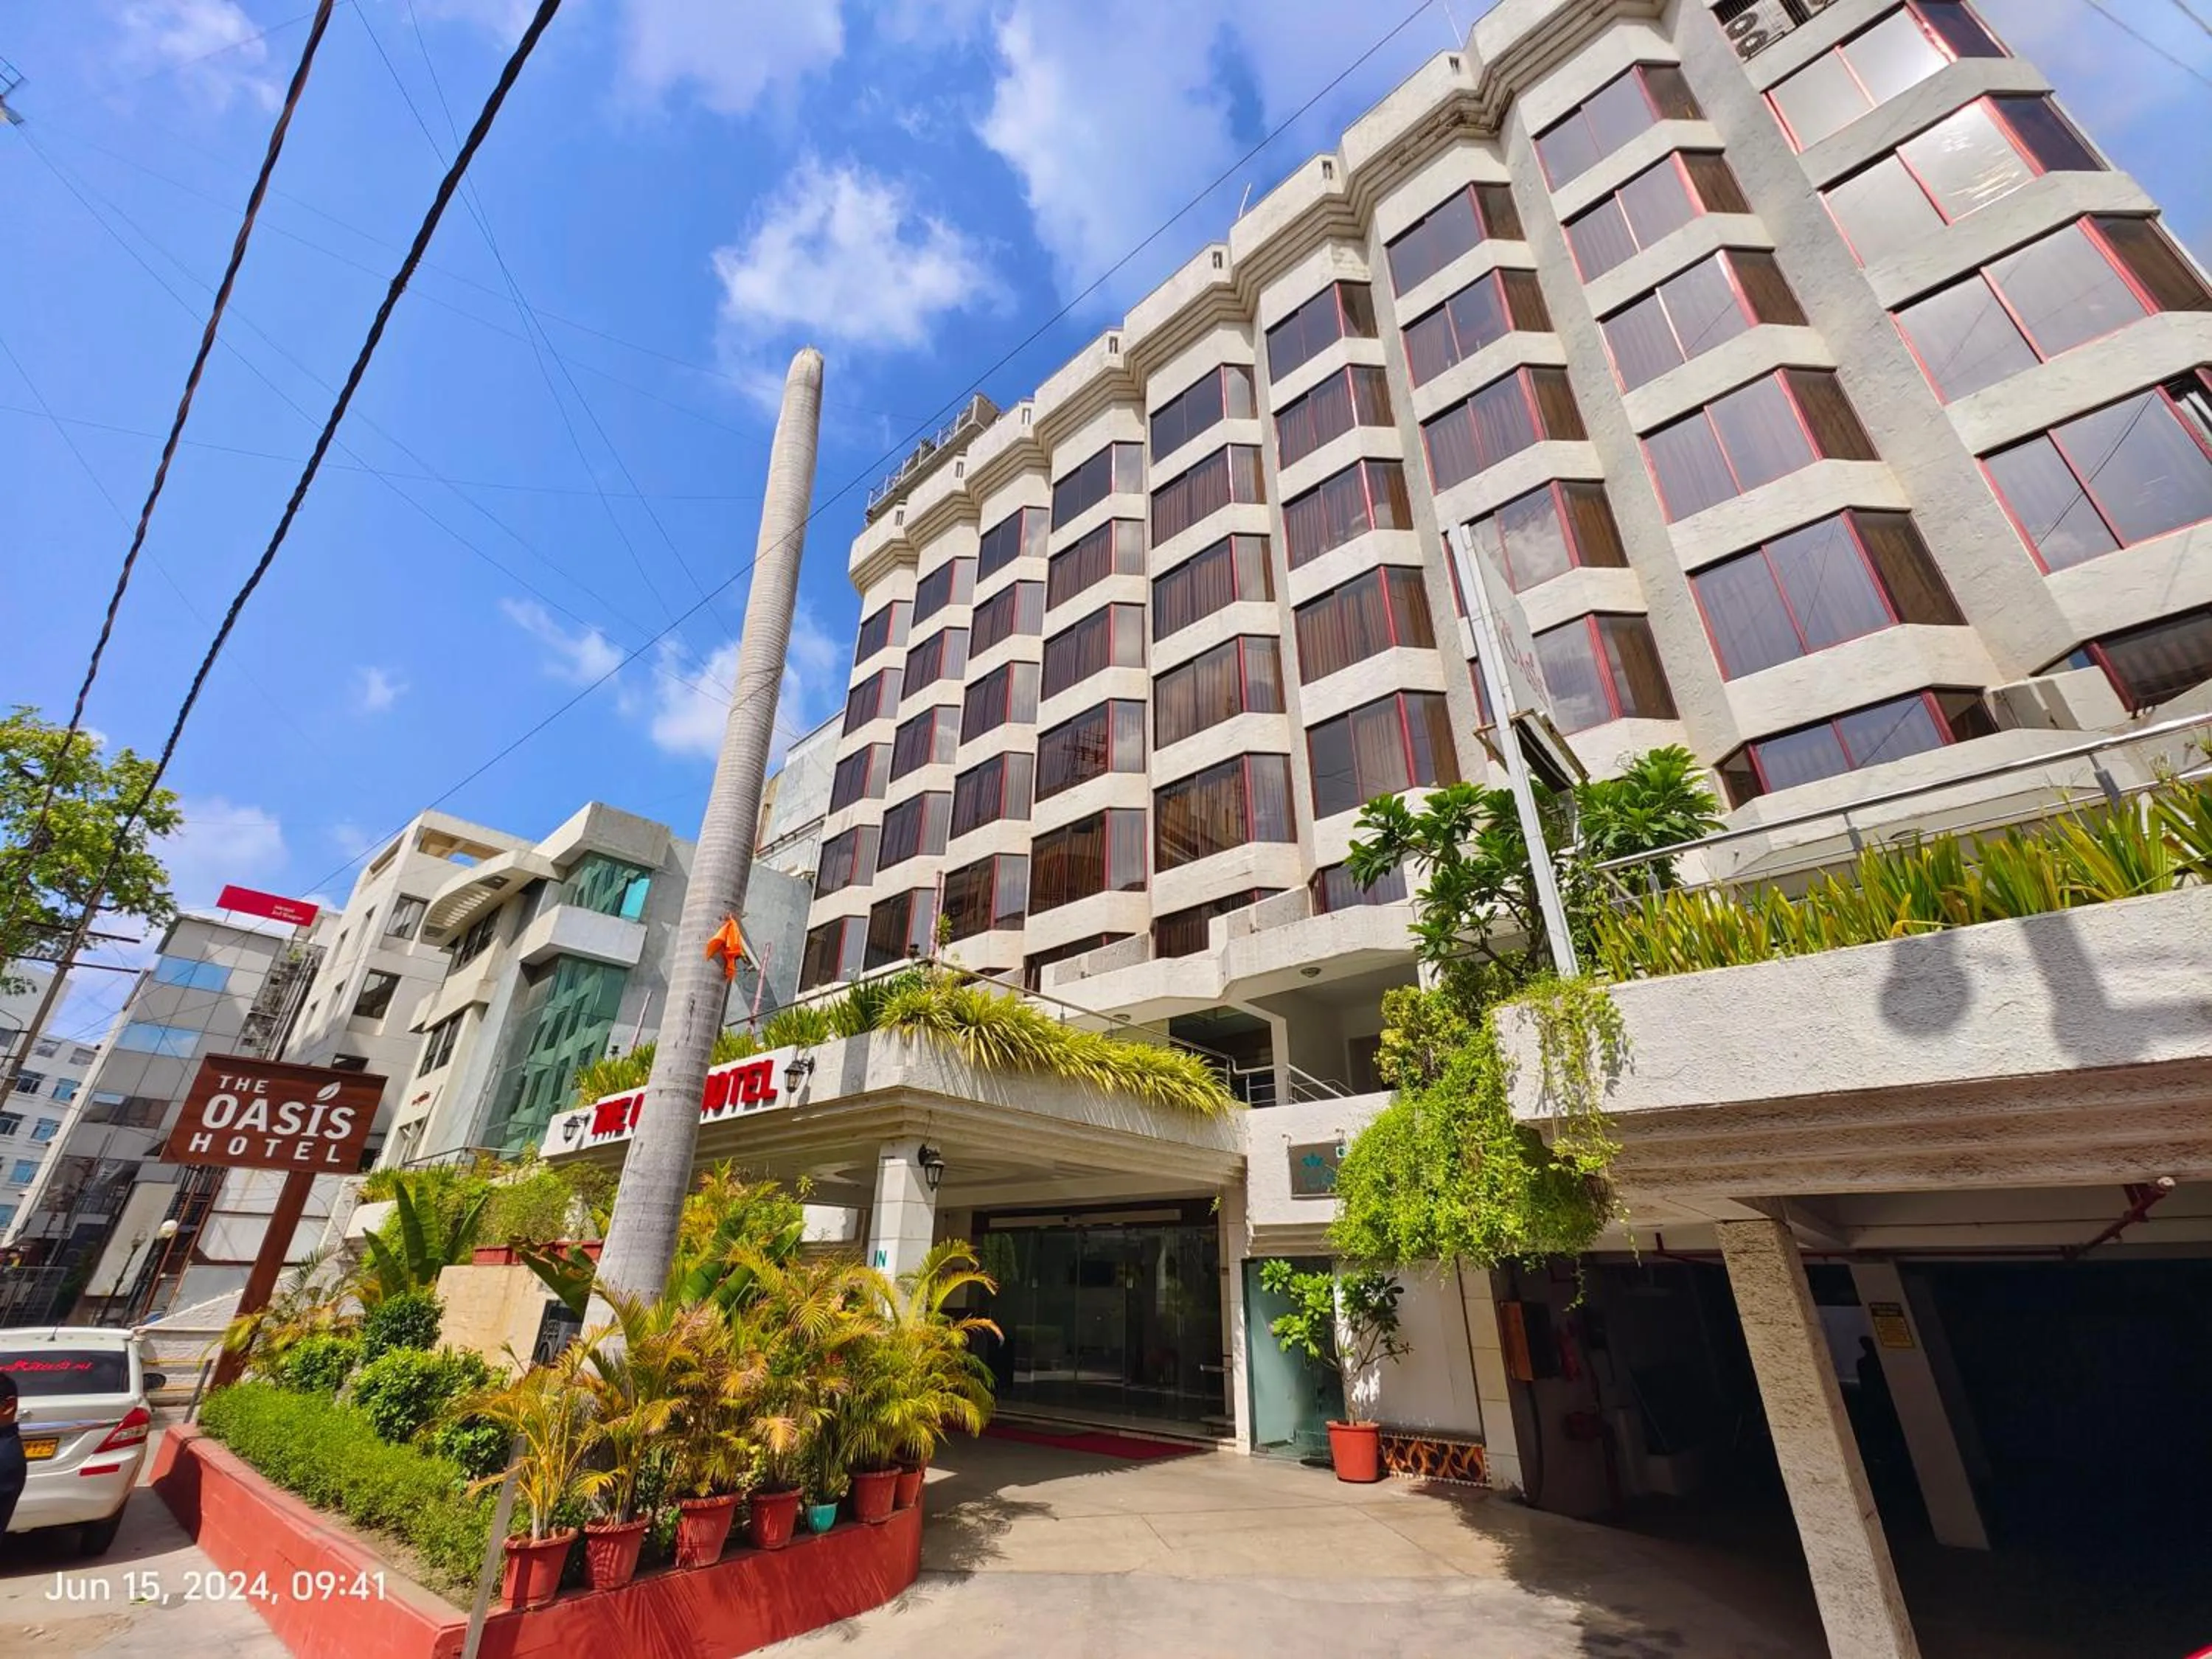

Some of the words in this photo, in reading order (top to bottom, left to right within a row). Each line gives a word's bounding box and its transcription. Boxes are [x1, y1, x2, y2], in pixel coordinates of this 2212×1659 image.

[219, 1075, 269, 1093] THE
[201, 1093, 356, 1139] OASIS
[188, 1133, 341, 1163] HOTEL
